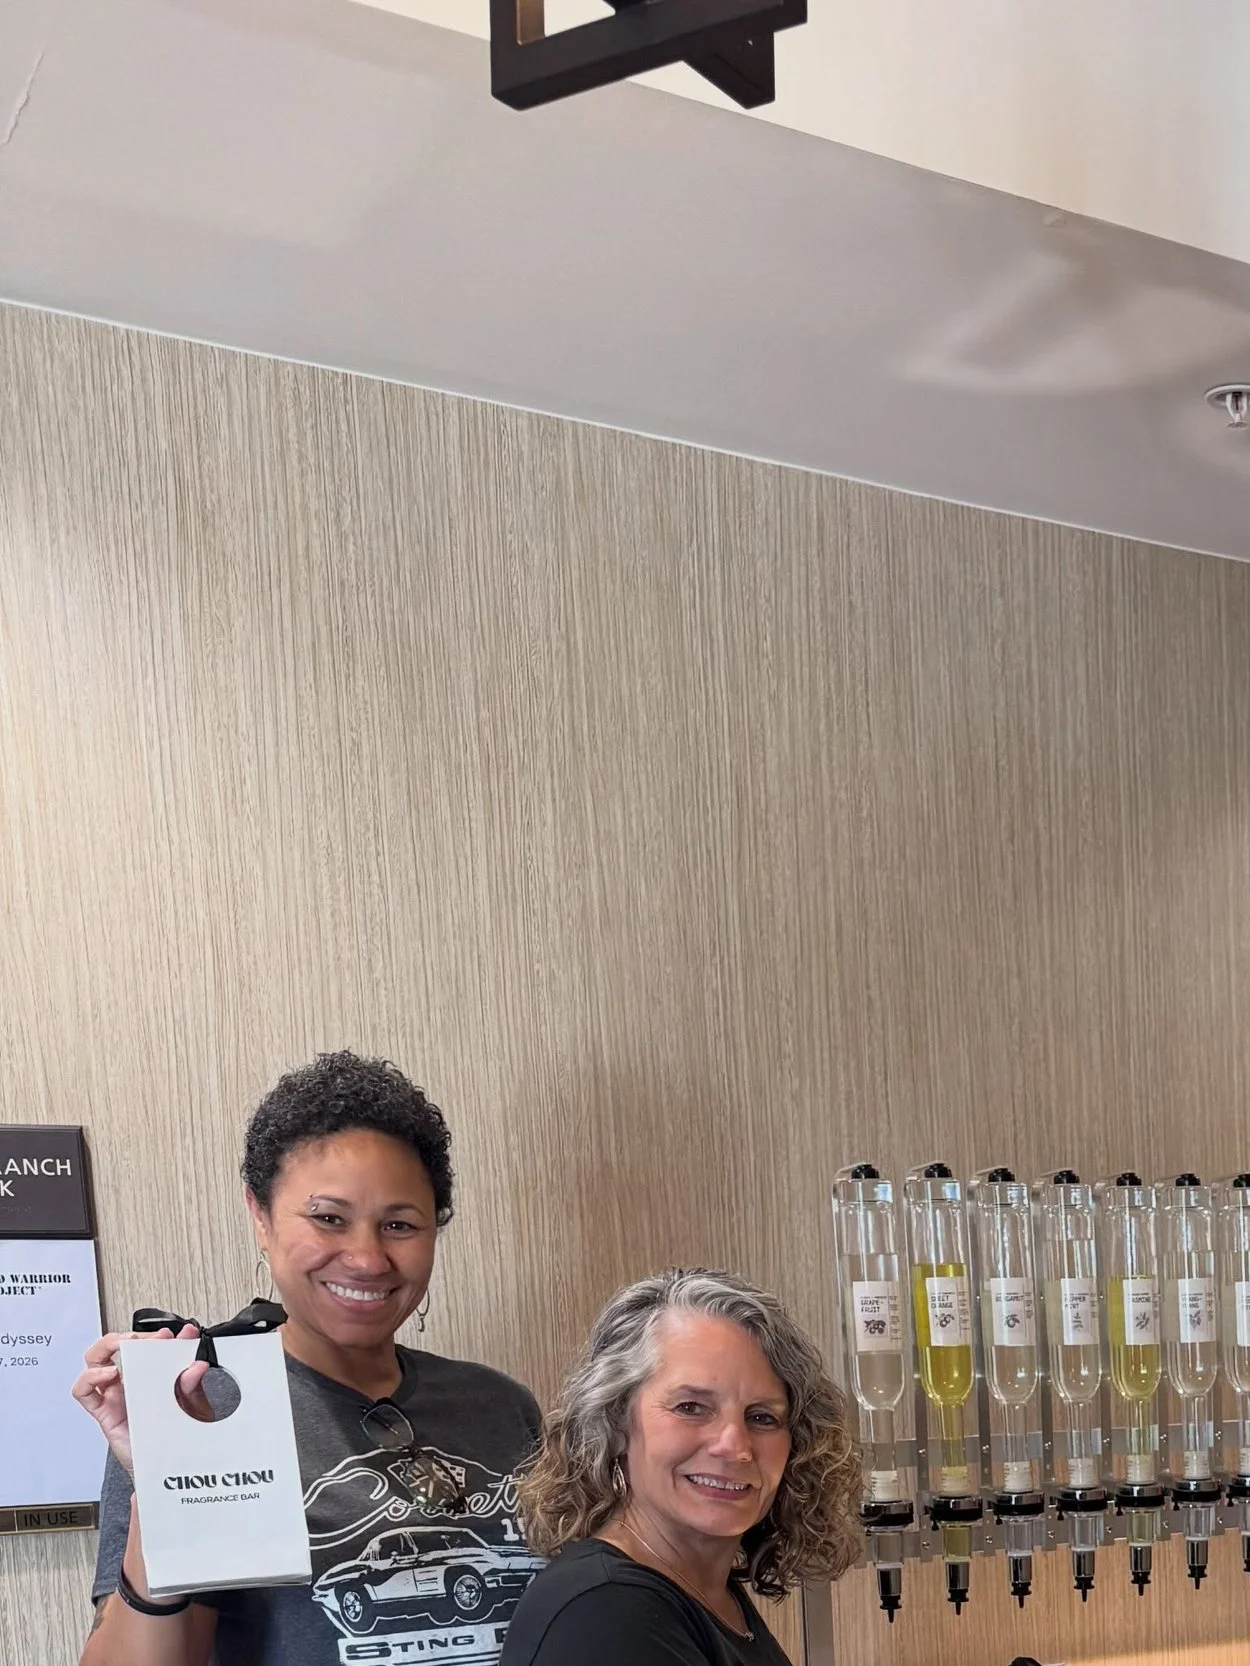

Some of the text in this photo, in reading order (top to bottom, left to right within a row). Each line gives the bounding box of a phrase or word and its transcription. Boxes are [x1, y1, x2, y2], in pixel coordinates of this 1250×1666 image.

[0, 1158, 72, 1176] ANCH
[0, 1180, 15, 1197] K
[10, 1274, 71, 1283] WARRIOR
[0, 1286, 36, 1295] OJECT
[0, 1333, 52, 1346] dyssey
[10, 1357, 39, 1366] 2026
[163, 1469, 274, 1490] CHOU CHOU
[181, 1492, 260, 1504] FRAGRANCE BAR
[24, 1511, 78, 1527] IN USE
[345, 1635, 475, 1660] STING
